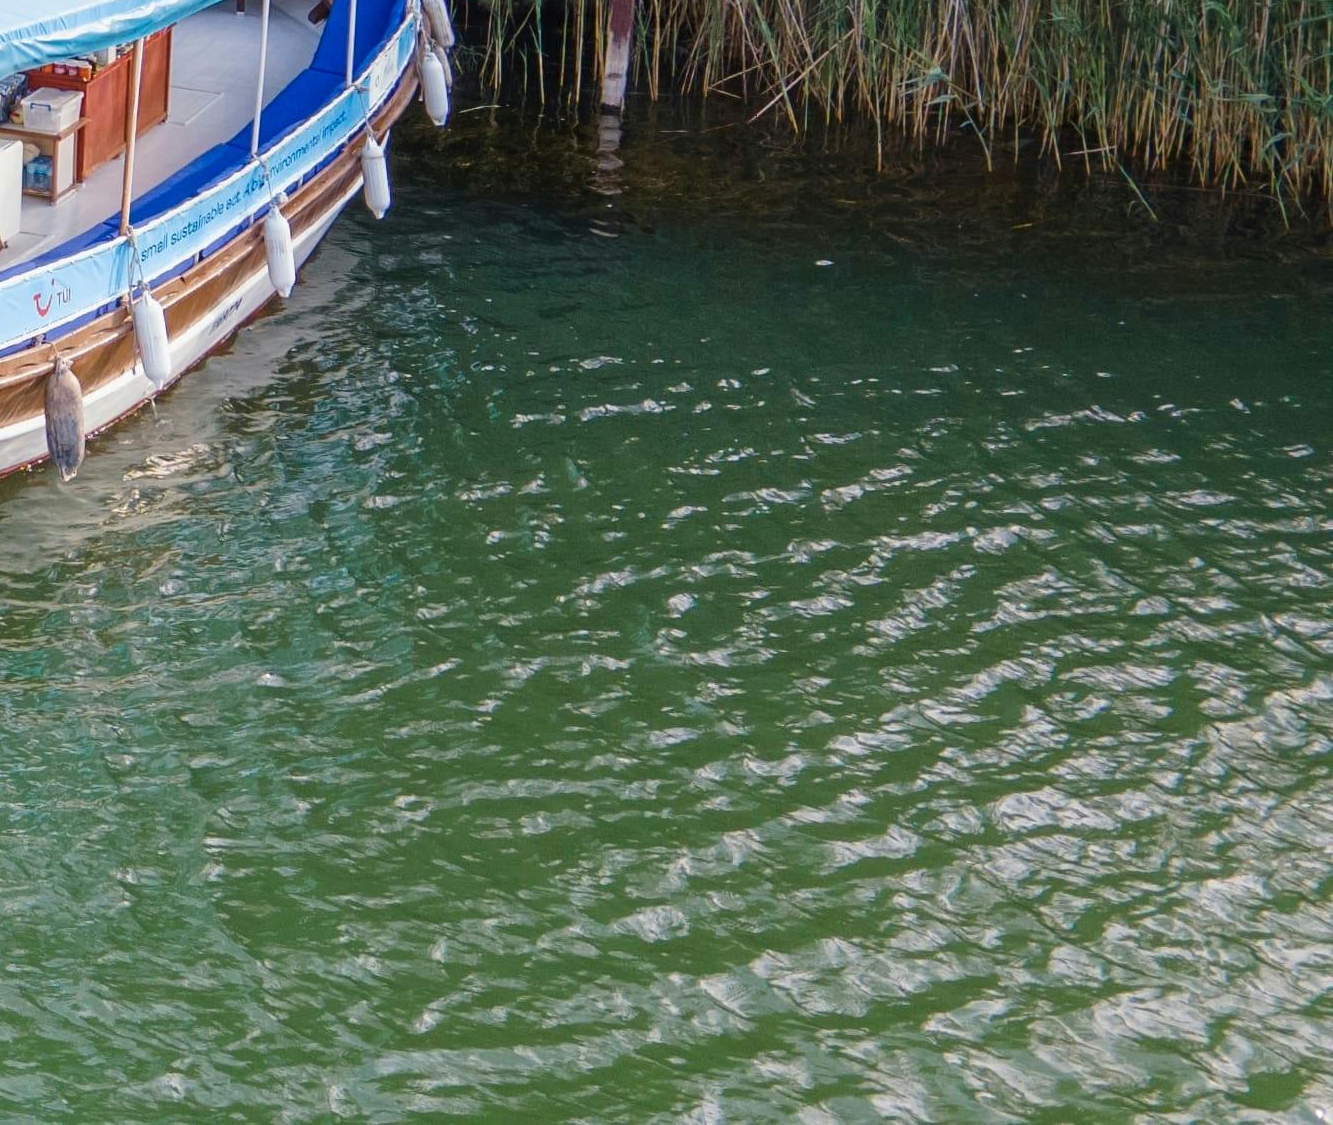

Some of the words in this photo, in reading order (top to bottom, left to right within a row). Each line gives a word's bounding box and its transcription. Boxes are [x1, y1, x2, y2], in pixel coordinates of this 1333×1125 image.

[140, 232, 169, 263] small
[170, 201, 225, 246] sustainable
[269, 128, 322, 180] nvironmental
[56, 286, 71, 307] TUI
